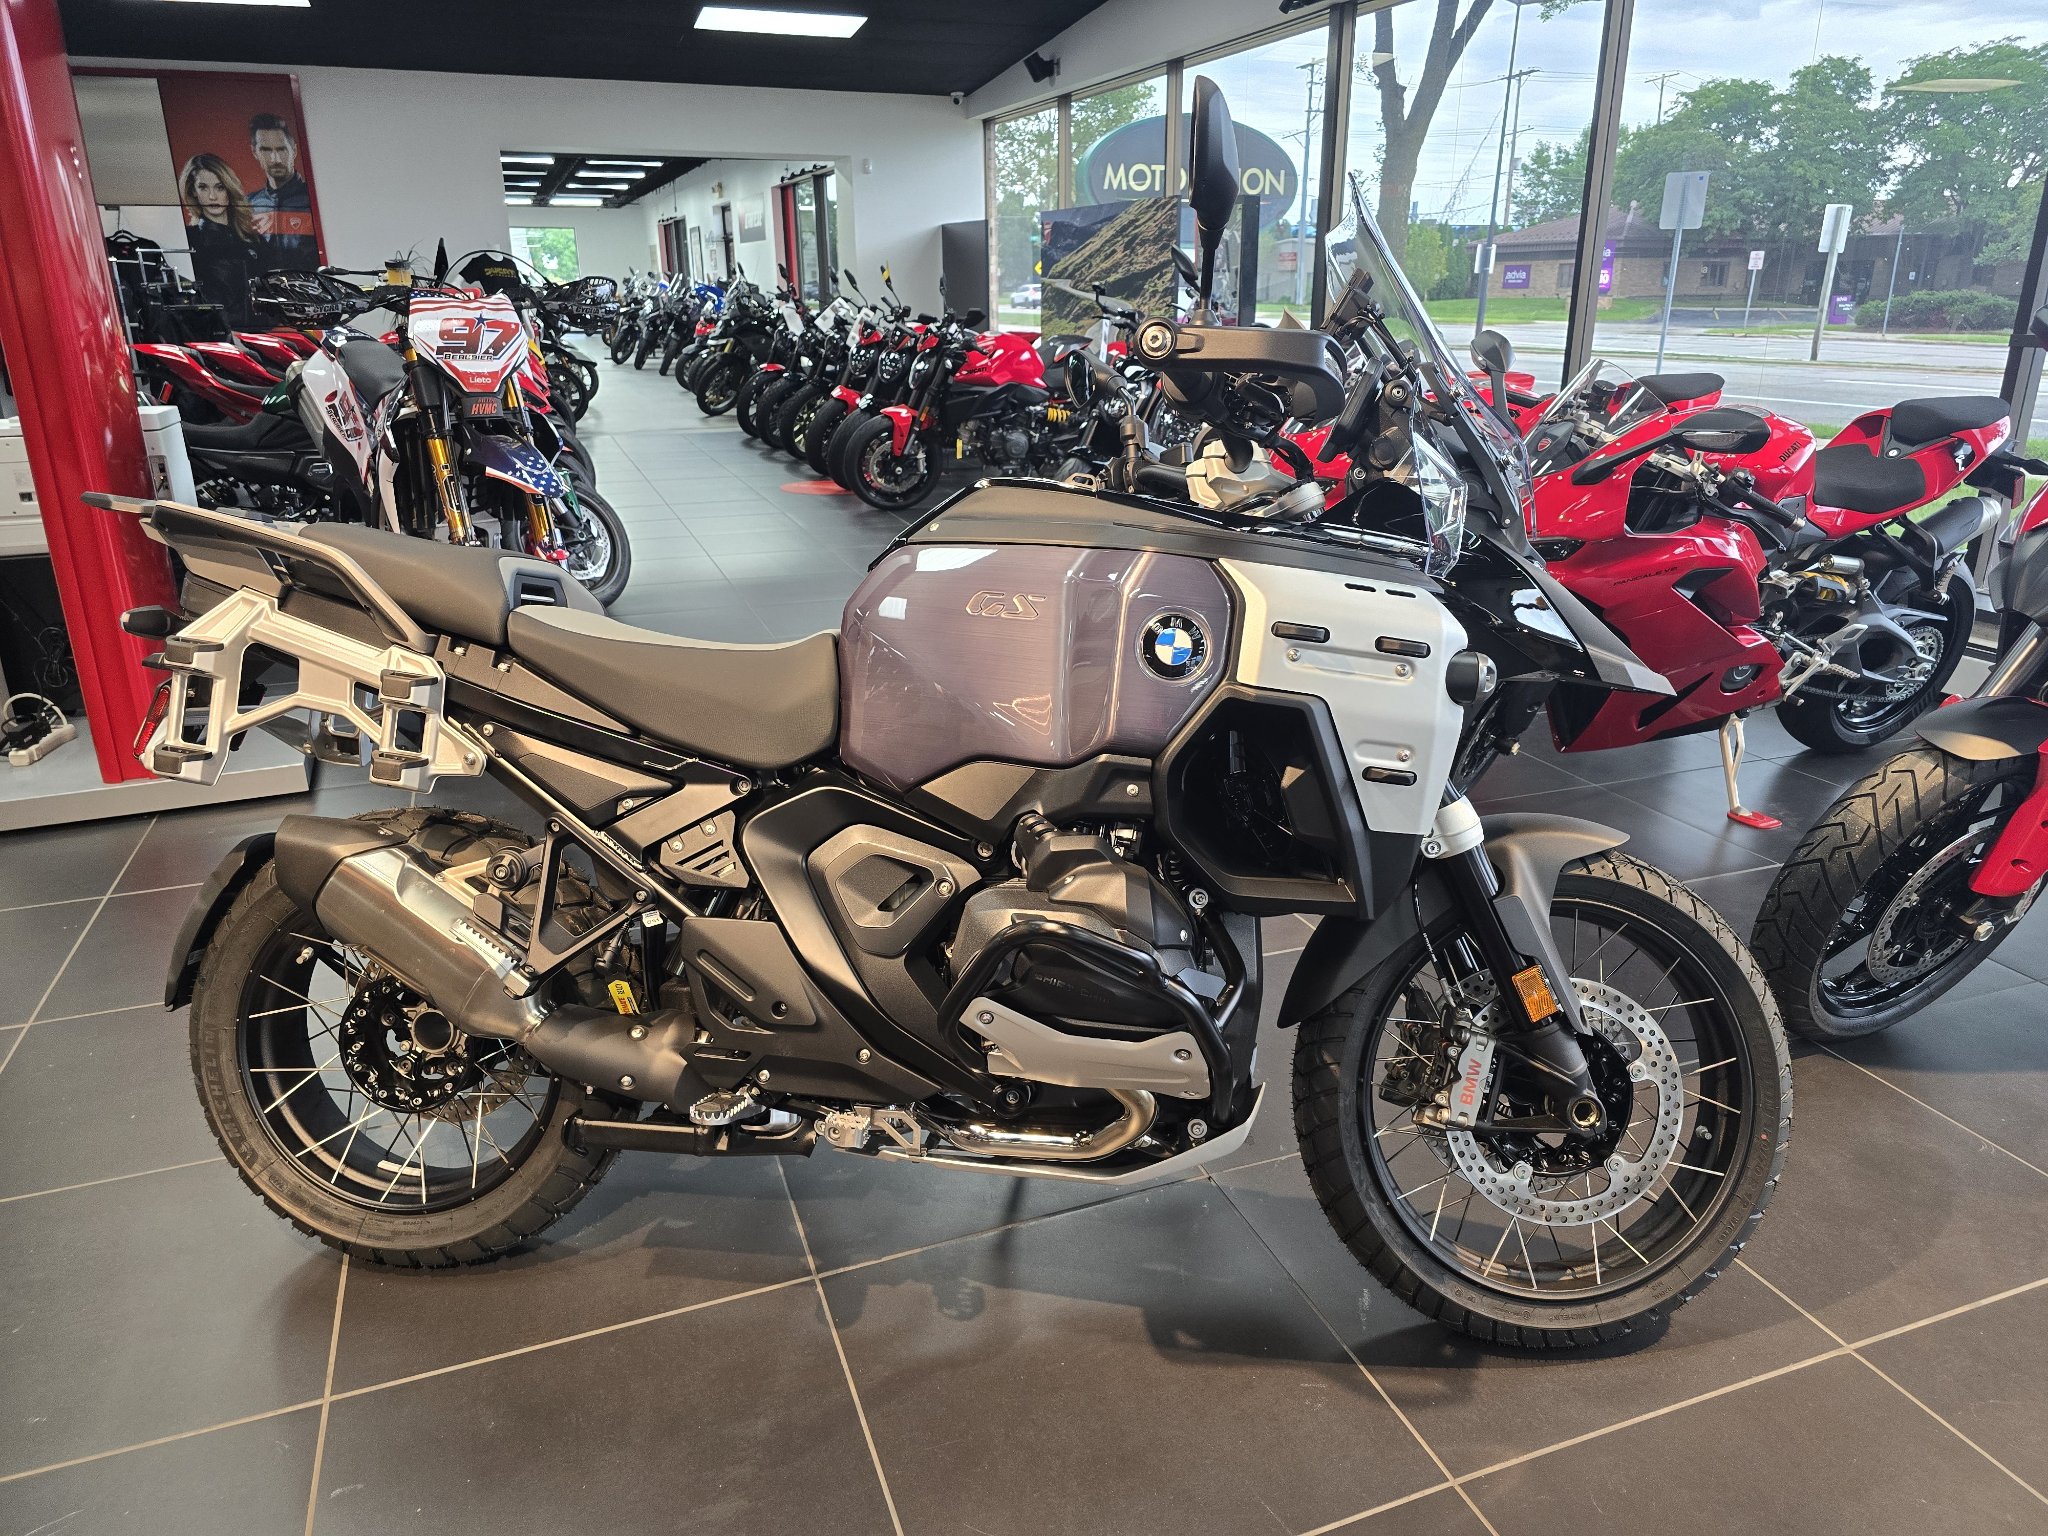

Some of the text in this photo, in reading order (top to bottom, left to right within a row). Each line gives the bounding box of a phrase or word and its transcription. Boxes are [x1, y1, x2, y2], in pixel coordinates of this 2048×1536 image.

[436, 317, 522, 356] 97
[470, 403, 498, 416] HVMC
[1778, 440, 1803, 463] DUCATI
[965, 589, 1048, 621] GS
[1152, 616, 1202, 641] BMW
[203, 1021, 244, 1141] MICHELIN
[1460, 1057, 1483, 1106] BMW
